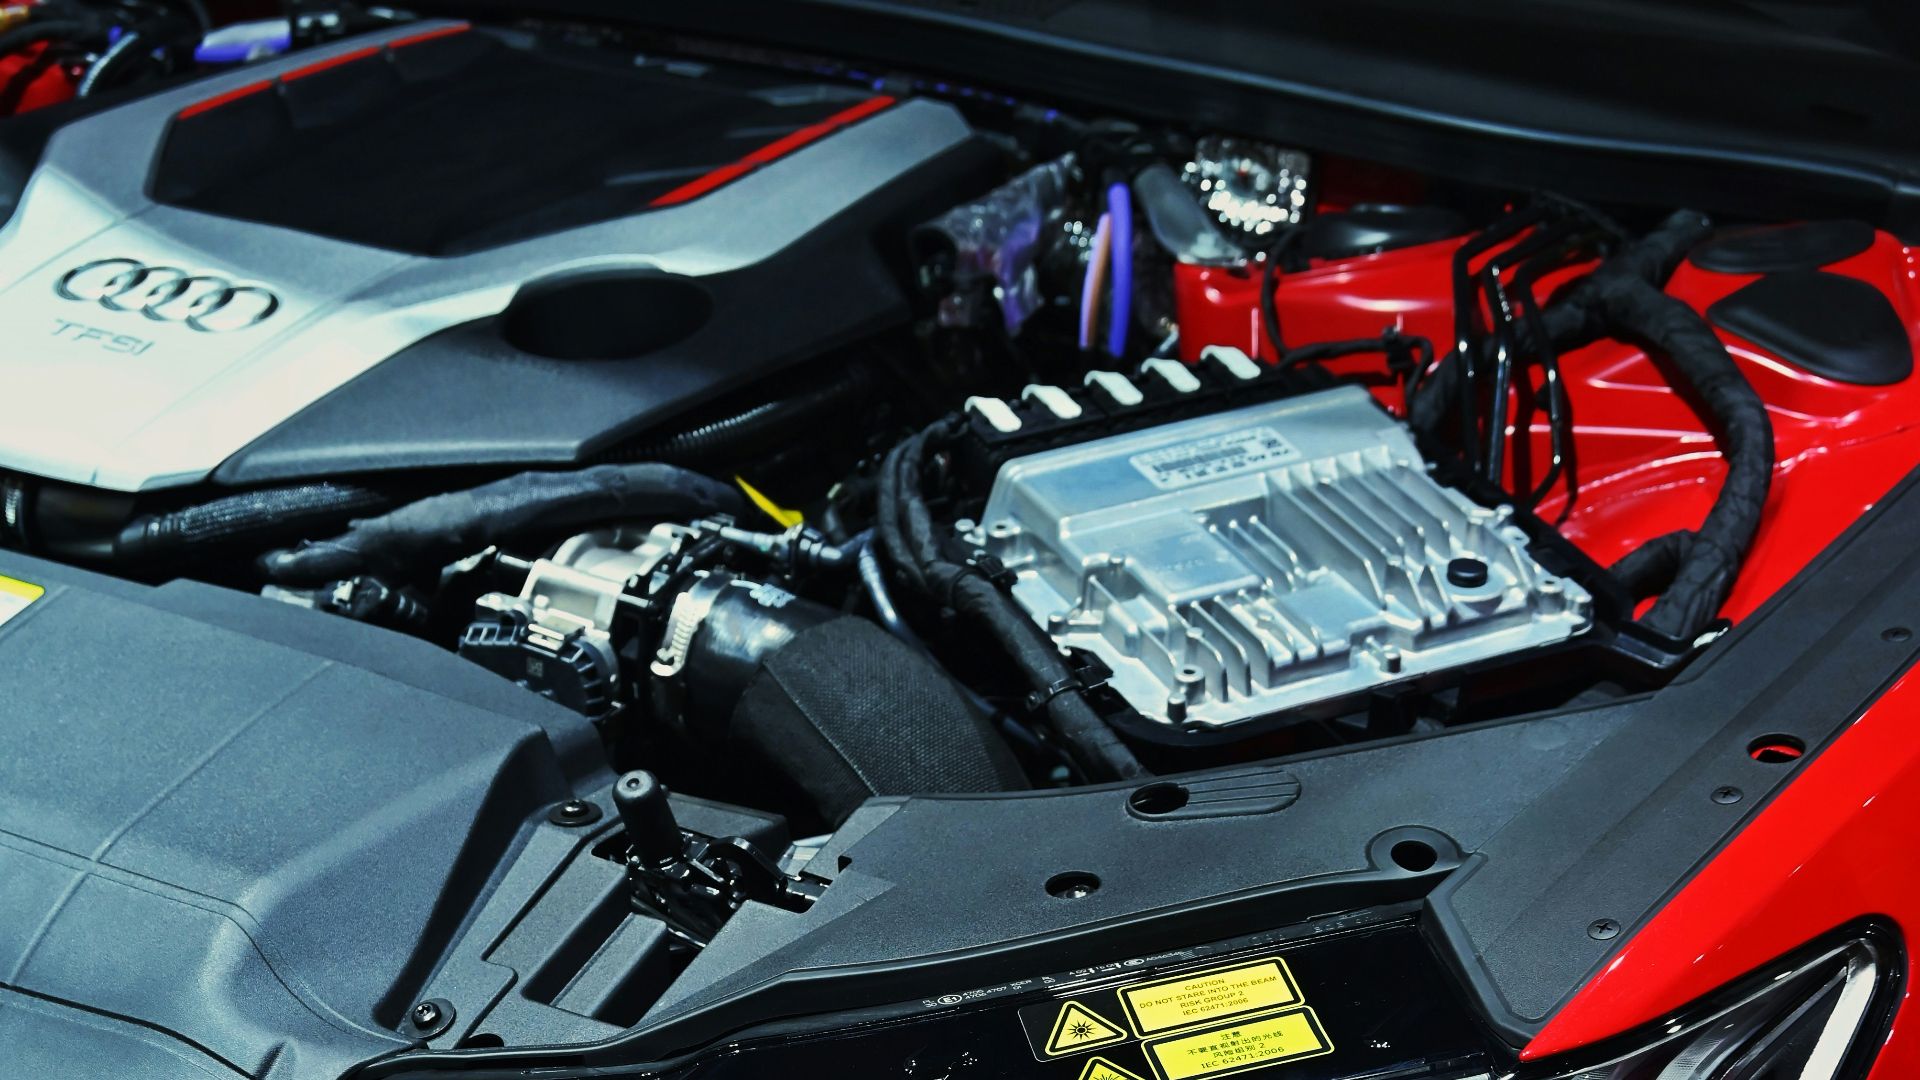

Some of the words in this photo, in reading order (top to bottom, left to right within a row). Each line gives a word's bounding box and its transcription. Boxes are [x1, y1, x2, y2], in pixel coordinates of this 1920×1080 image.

[51, 319, 155, 356] TFSI
[1139, 1001, 1153, 1009] DO
[1155, 997, 1173, 1005] NOT
[1176, 990, 1206, 1002] STARE
[1207, 985, 1229, 994] INTO
[1232, 981, 1249, 989] THE
[1251, 976, 1277, 986] BEAM
[1185, 978, 1225, 991] CAUTION
[1180, 999, 1202, 1009] RISK
[1203, 992, 1236, 1003] GROUP
[1182, 1008, 1198, 1017] IEC
[1221, 1031, 1242, 1040] 注意
[1201, 1060, 1220, 1069] IEC
[1222, 1046, 1285, 1065] 62471:2006
